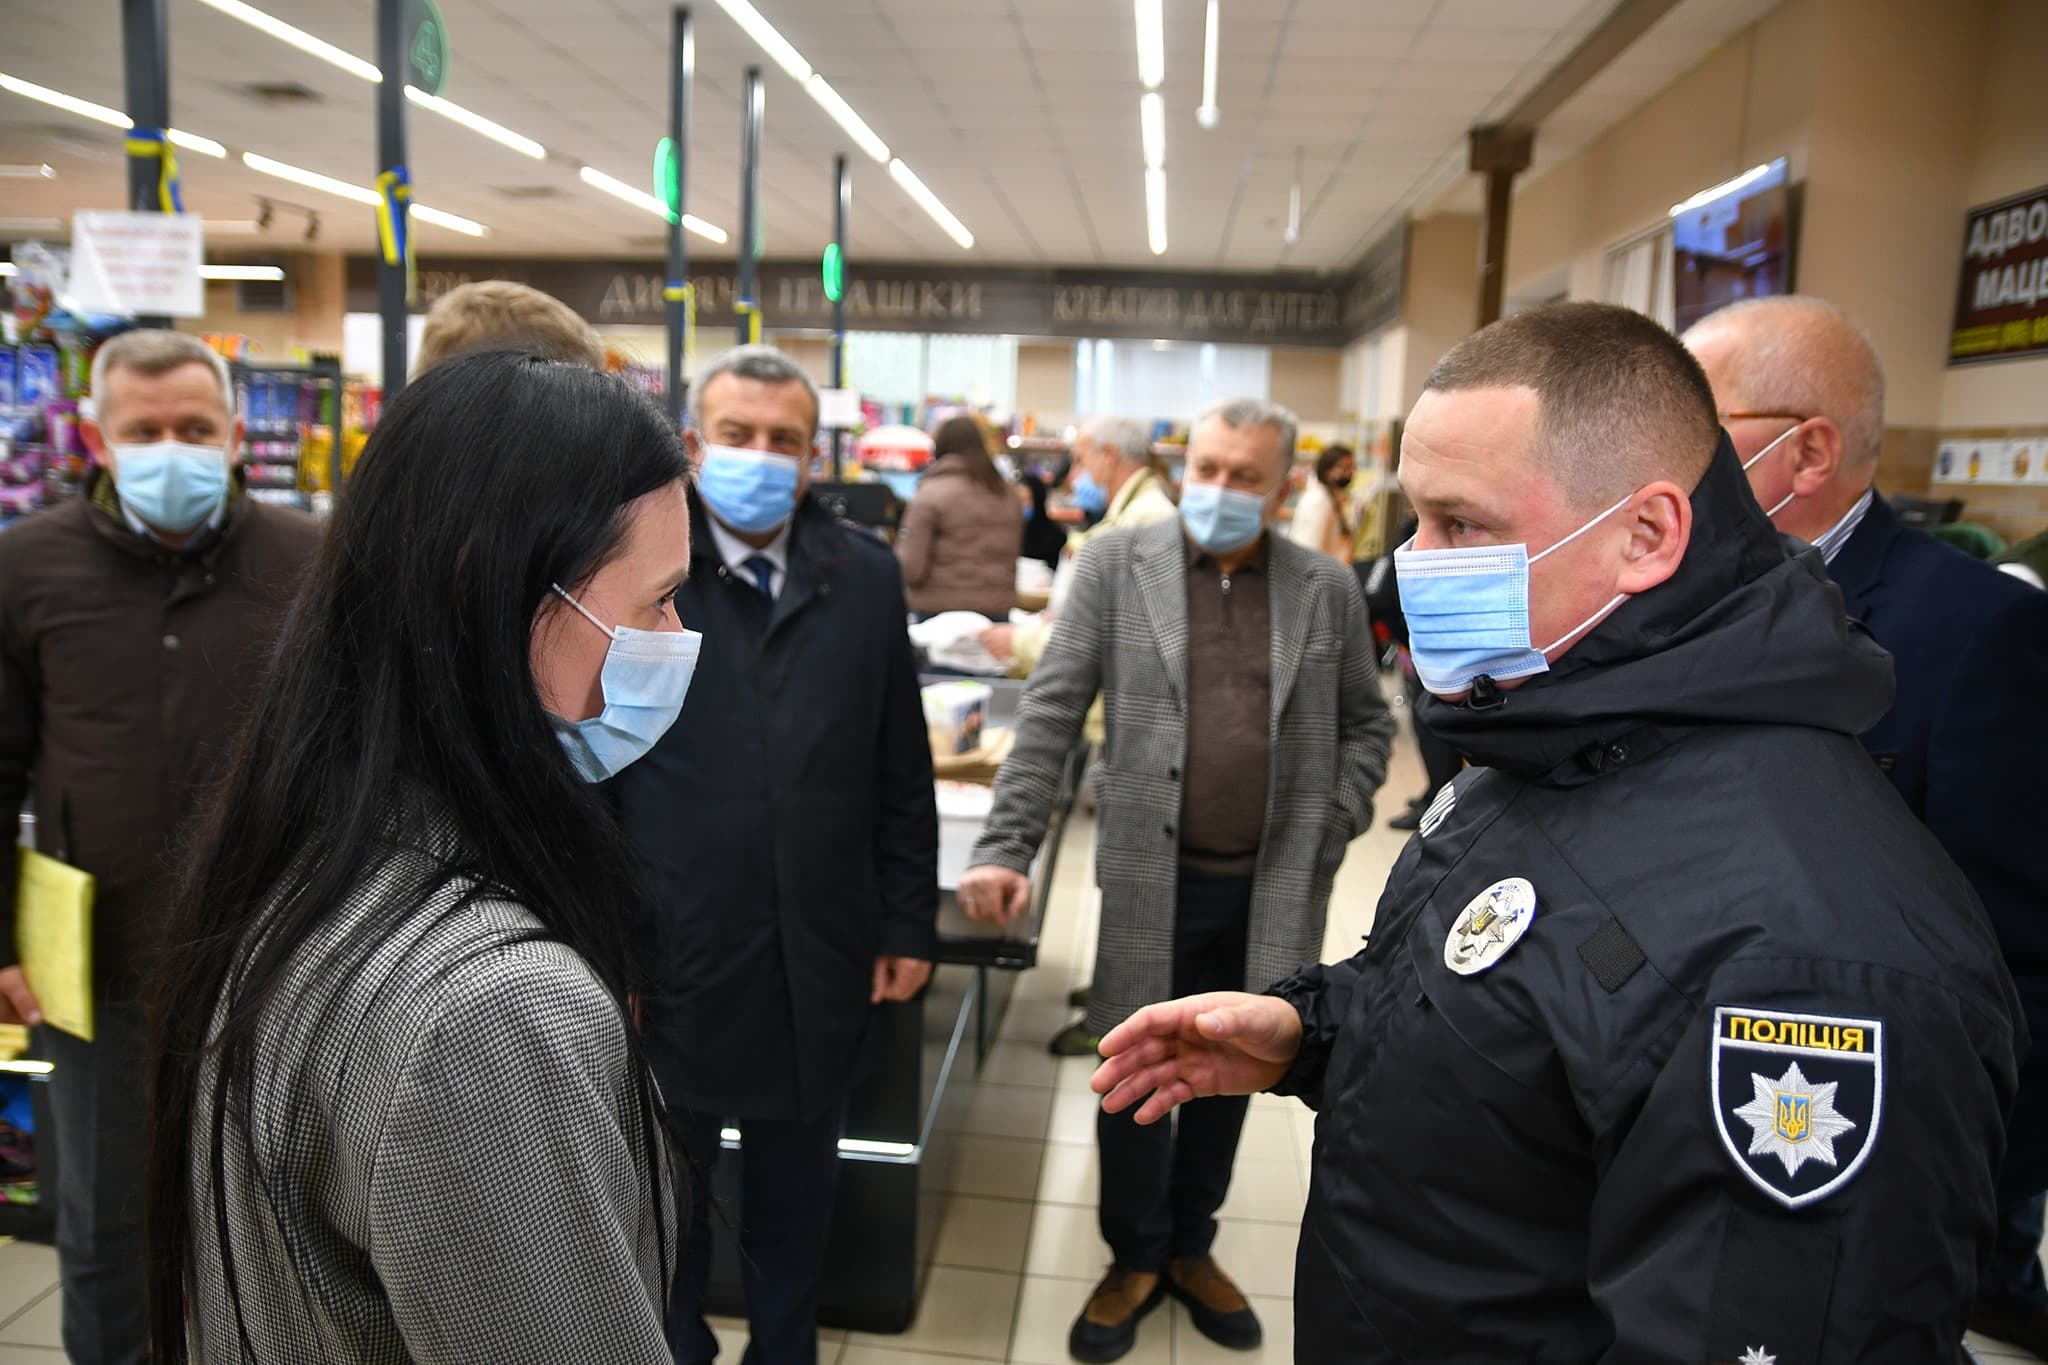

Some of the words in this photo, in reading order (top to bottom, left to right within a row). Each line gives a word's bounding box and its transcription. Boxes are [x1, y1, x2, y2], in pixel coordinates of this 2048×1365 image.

[1967, 200, 2048, 258] АДВО
[778, 277, 983, 321] ІГАШКИ
[1730, 1016, 1864, 1052] ПОЛІЦІЯ
